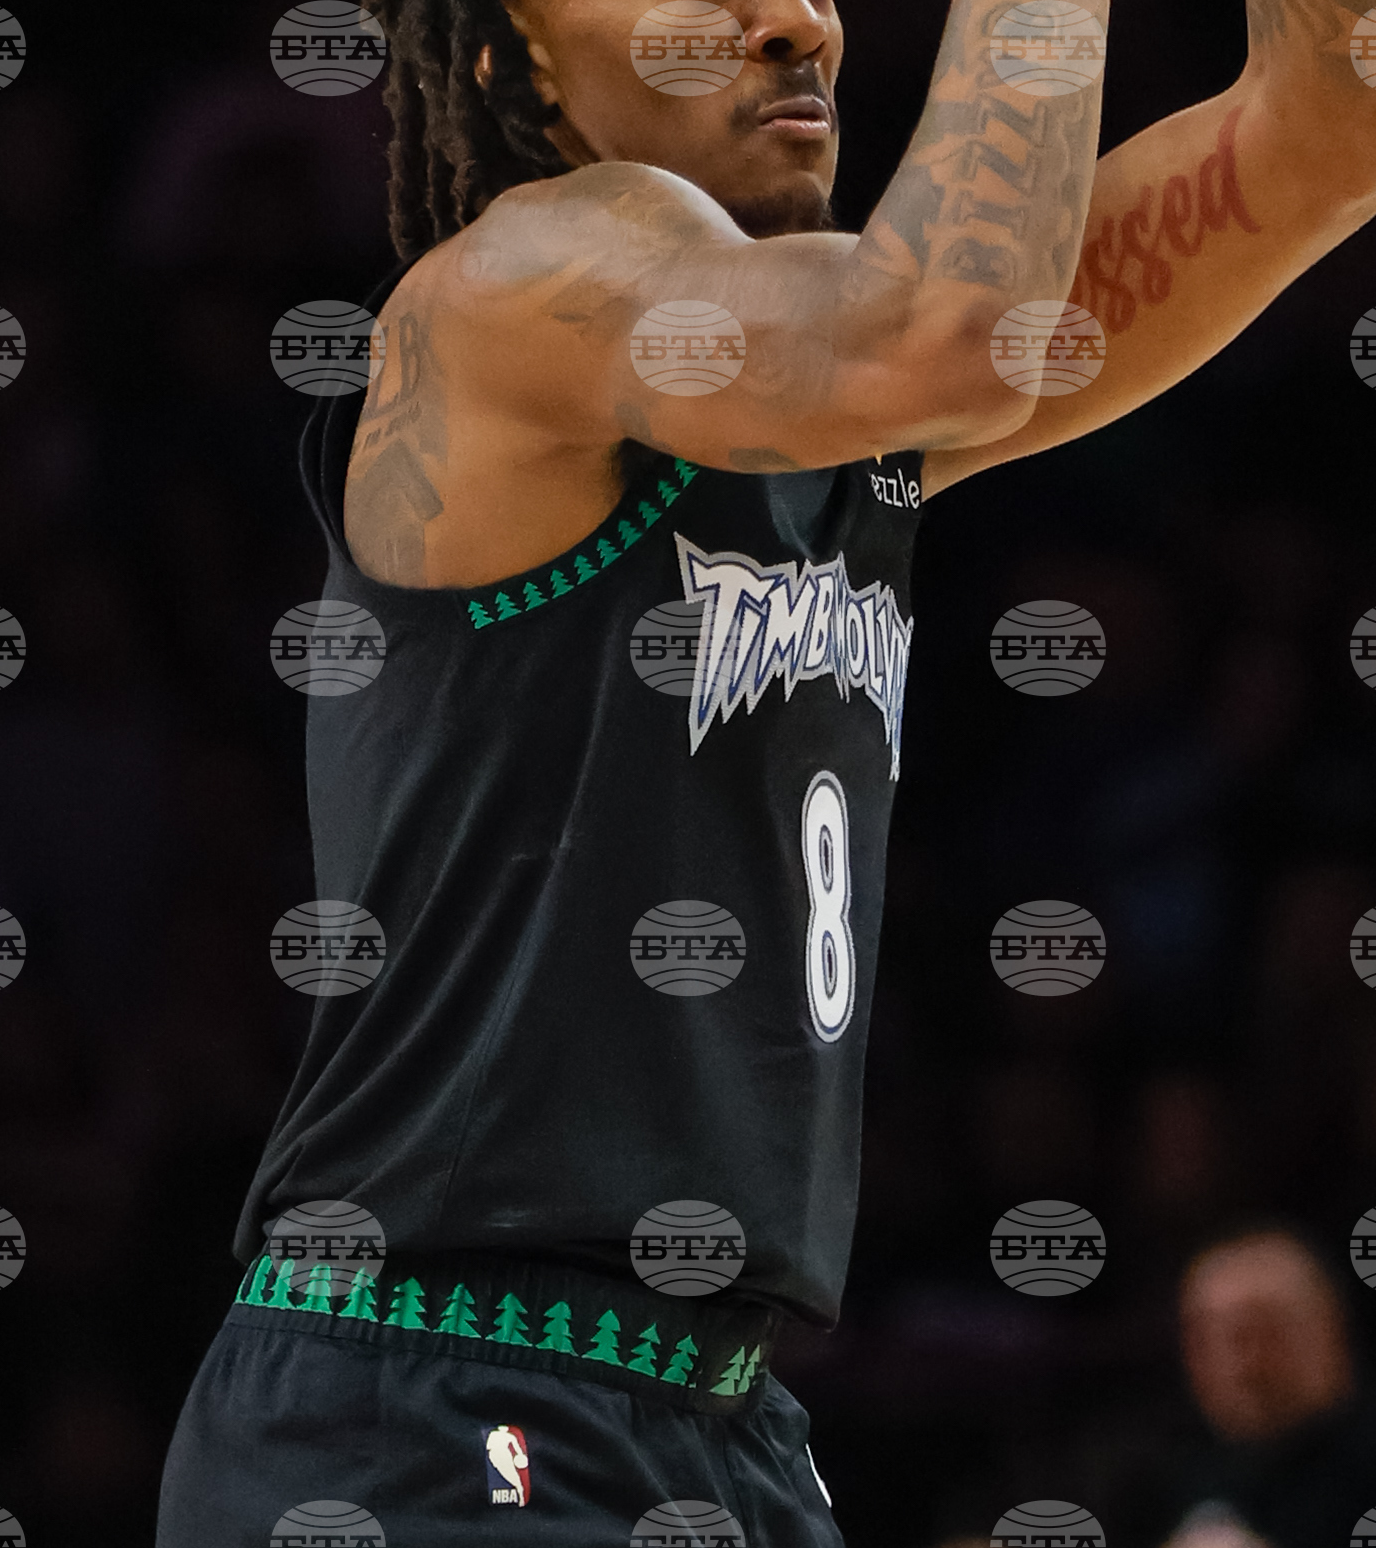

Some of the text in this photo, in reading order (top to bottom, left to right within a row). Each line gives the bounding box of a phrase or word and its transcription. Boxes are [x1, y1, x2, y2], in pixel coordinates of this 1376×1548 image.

[868, 468, 920, 510] ezzle
[801, 770, 856, 1044] 8
[491, 1488, 519, 1504] NBA
